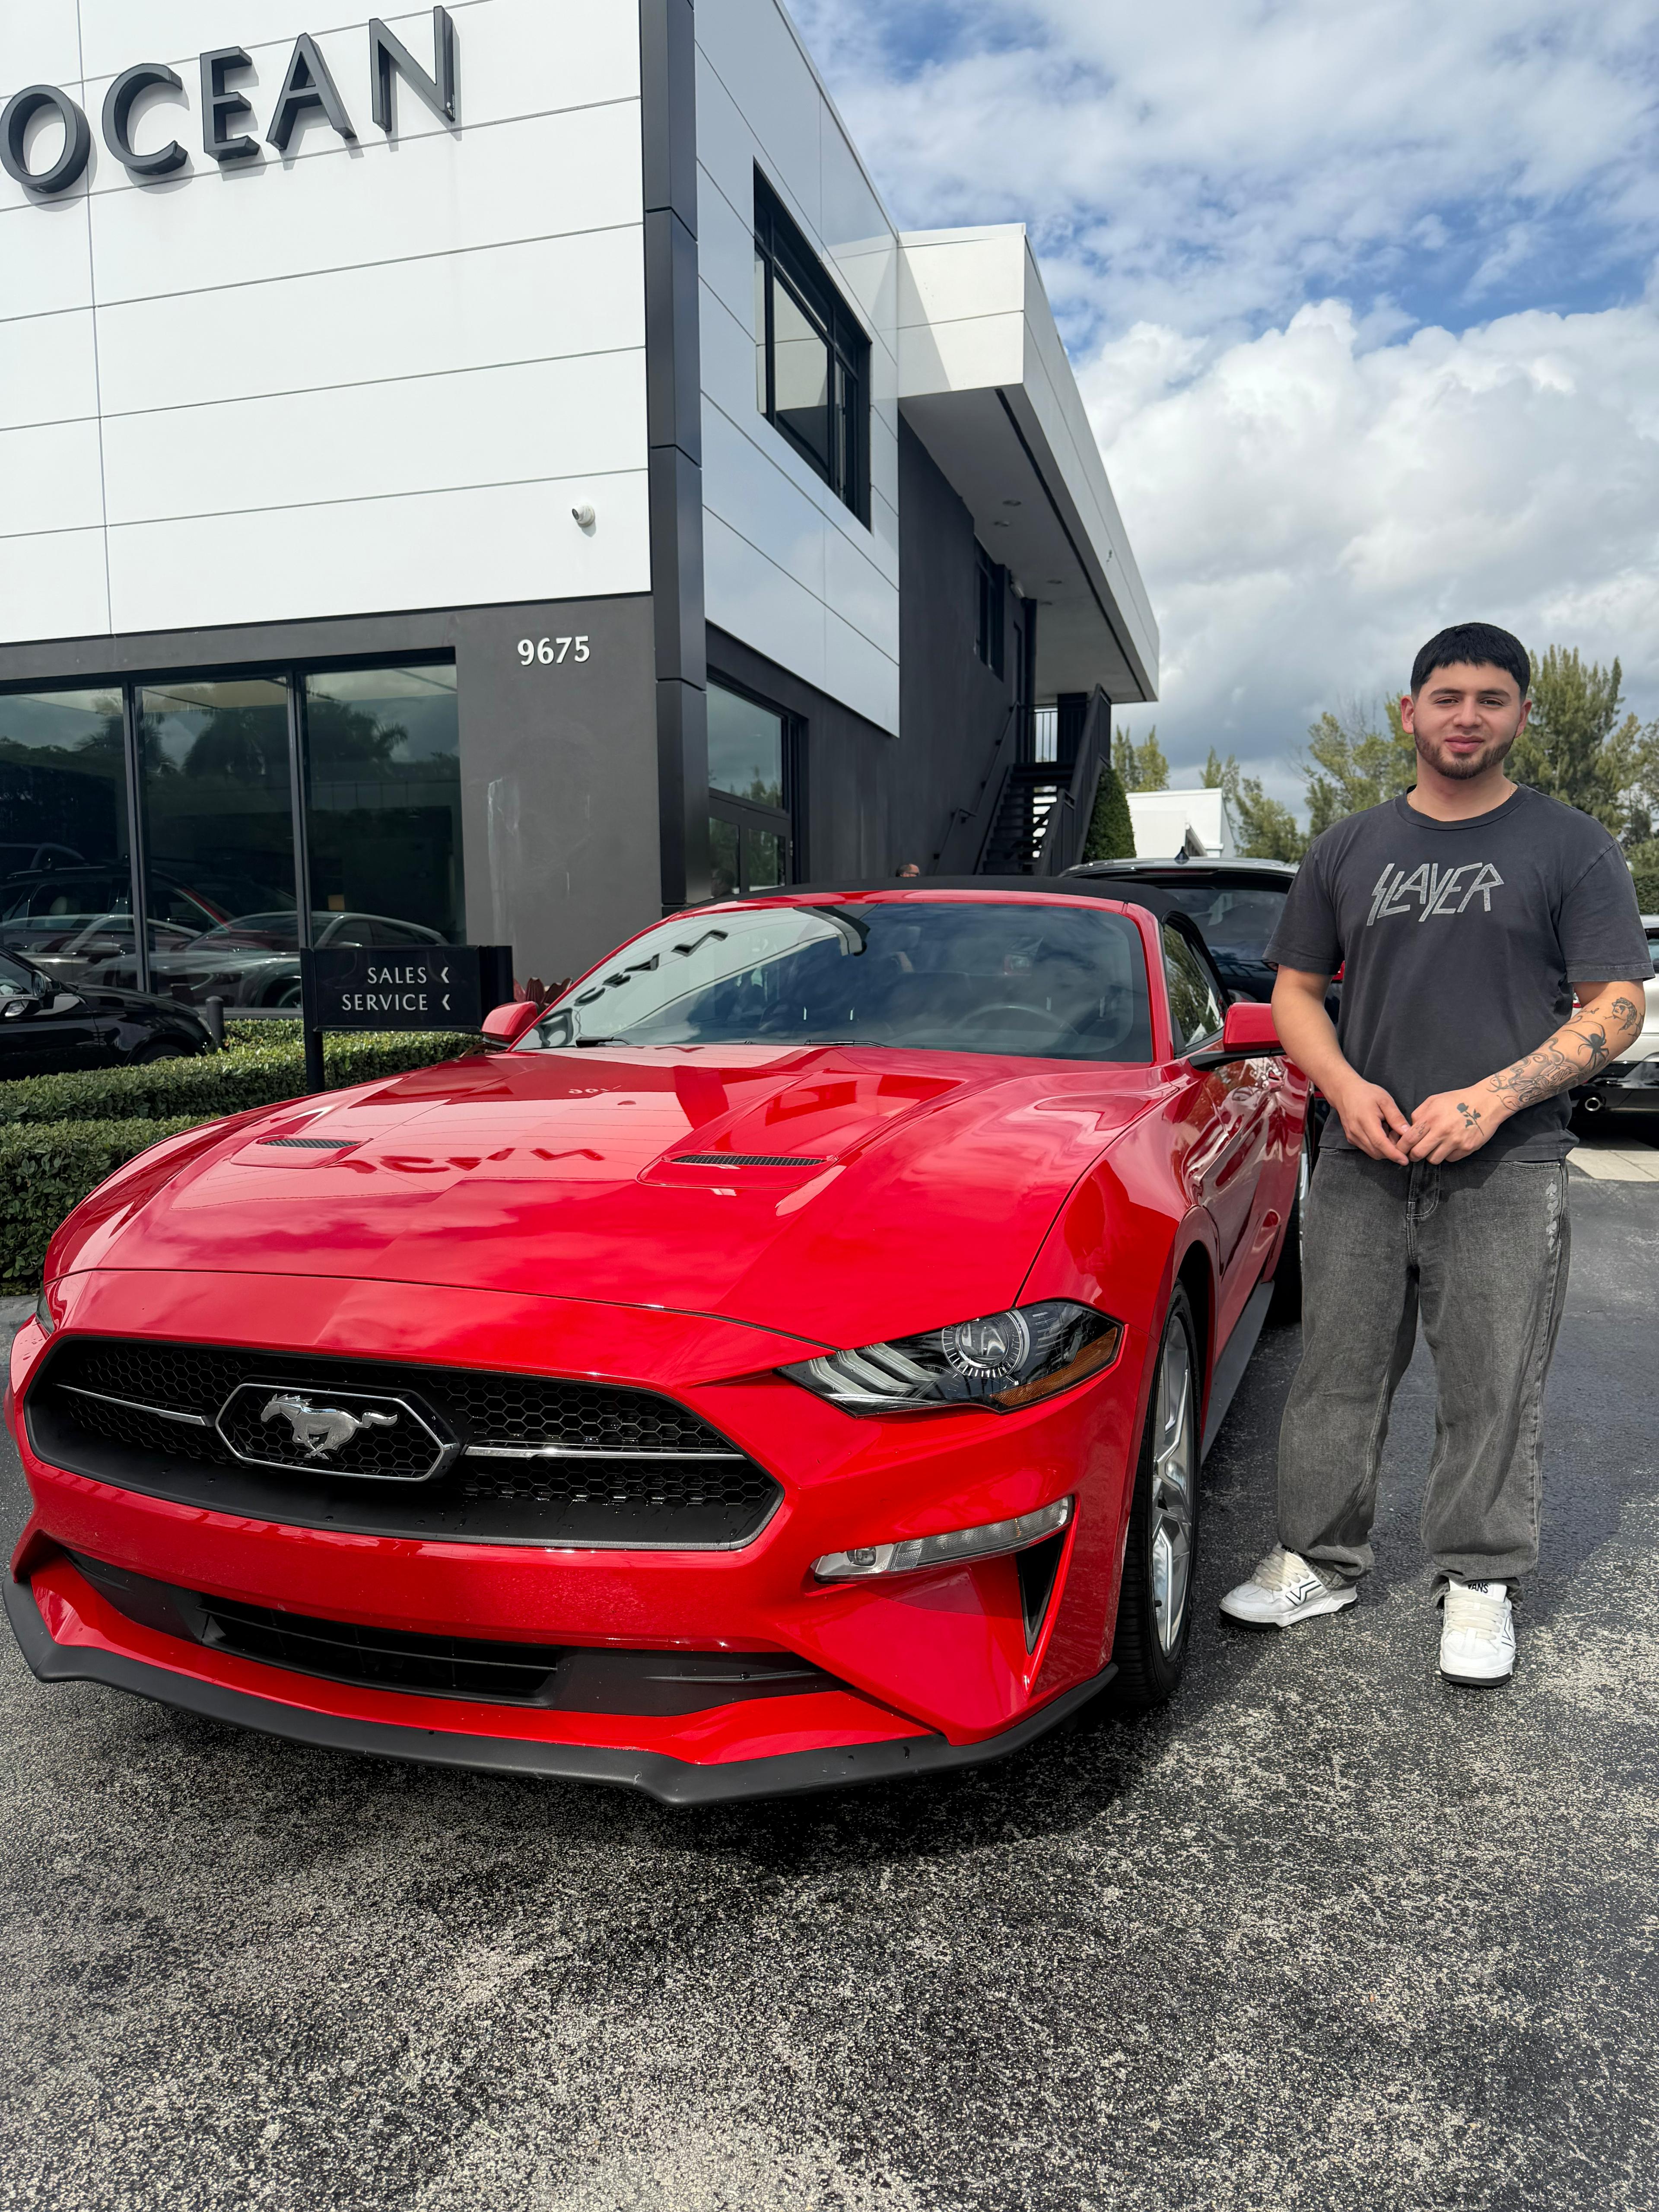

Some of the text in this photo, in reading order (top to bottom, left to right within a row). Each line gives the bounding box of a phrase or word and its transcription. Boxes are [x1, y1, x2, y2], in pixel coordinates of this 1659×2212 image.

[0, 6, 454, 193] OCEAN
[517, 636, 590, 666] 9675
[1367, 862, 1504, 926] SLAYER
[367, 967, 427, 984] SALES
[342, 994, 428, 1011] SERVICE
